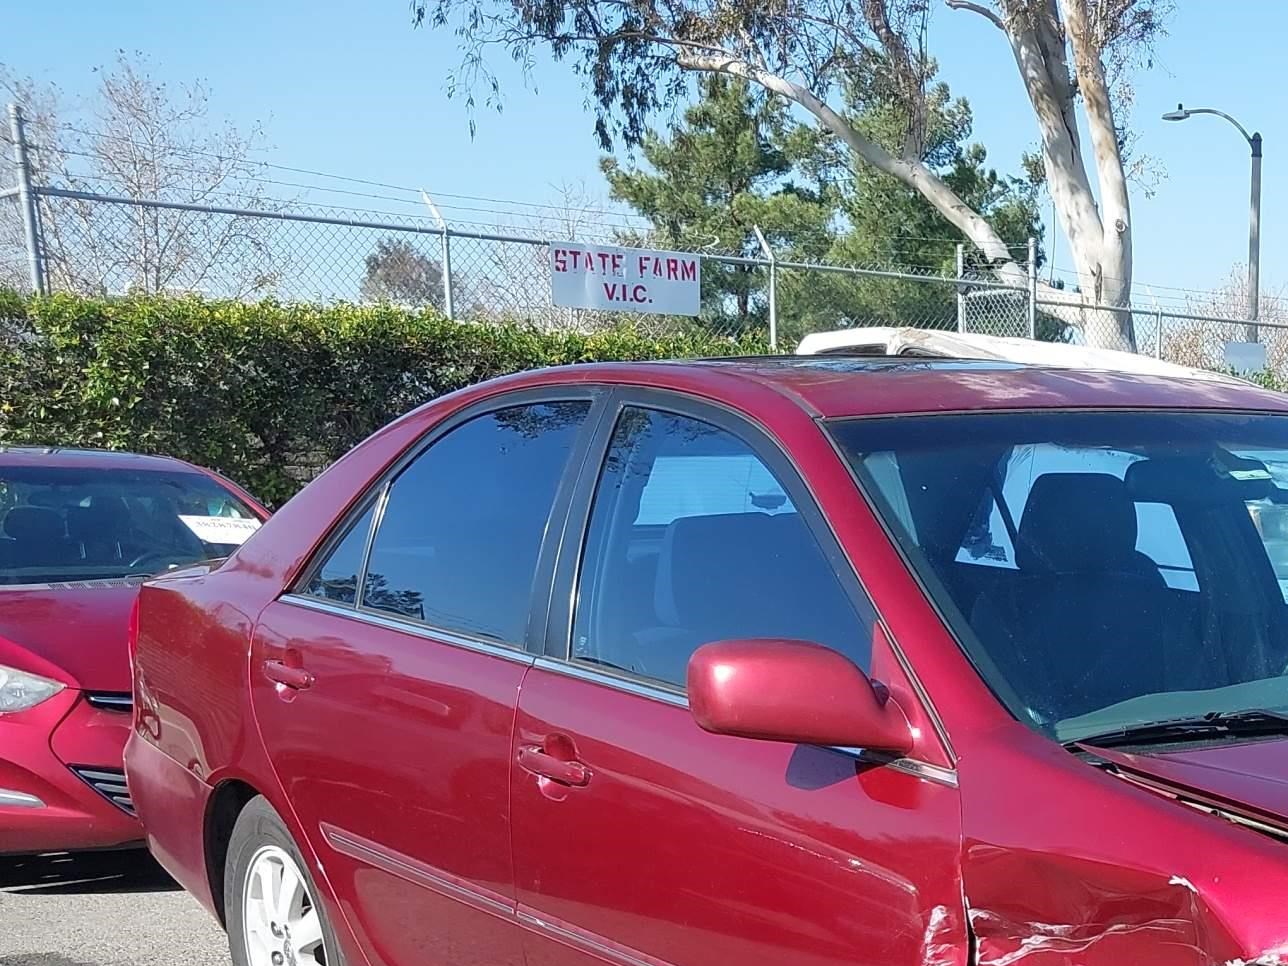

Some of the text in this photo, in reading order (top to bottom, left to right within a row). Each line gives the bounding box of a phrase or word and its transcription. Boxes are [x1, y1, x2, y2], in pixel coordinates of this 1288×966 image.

[554, 249, 697, 281] STATE FARM
[603, 282, 653, 303] V.I.C.
